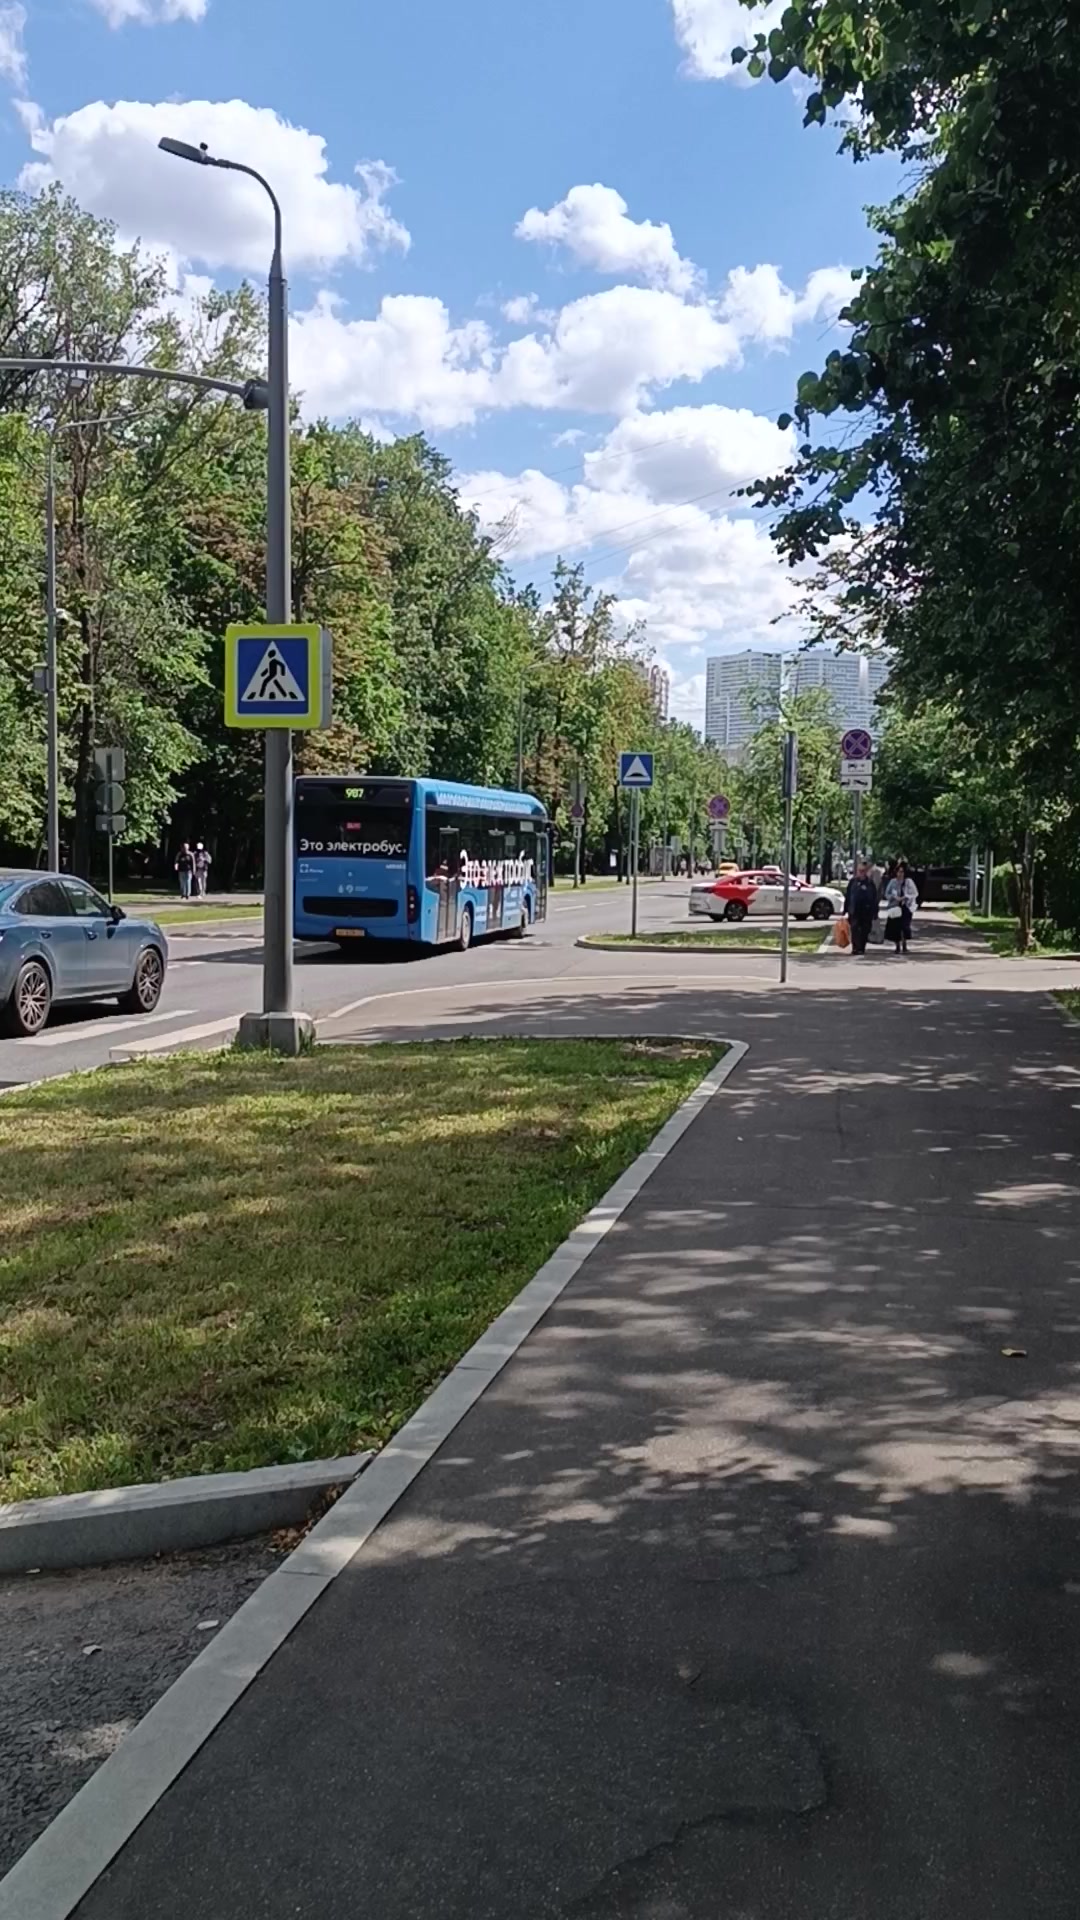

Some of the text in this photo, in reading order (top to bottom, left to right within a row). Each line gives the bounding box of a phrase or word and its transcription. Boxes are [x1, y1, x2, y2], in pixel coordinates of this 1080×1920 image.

[299, 838, 407, 855] Это электробус.
[459, 849, 480, 889] Это
